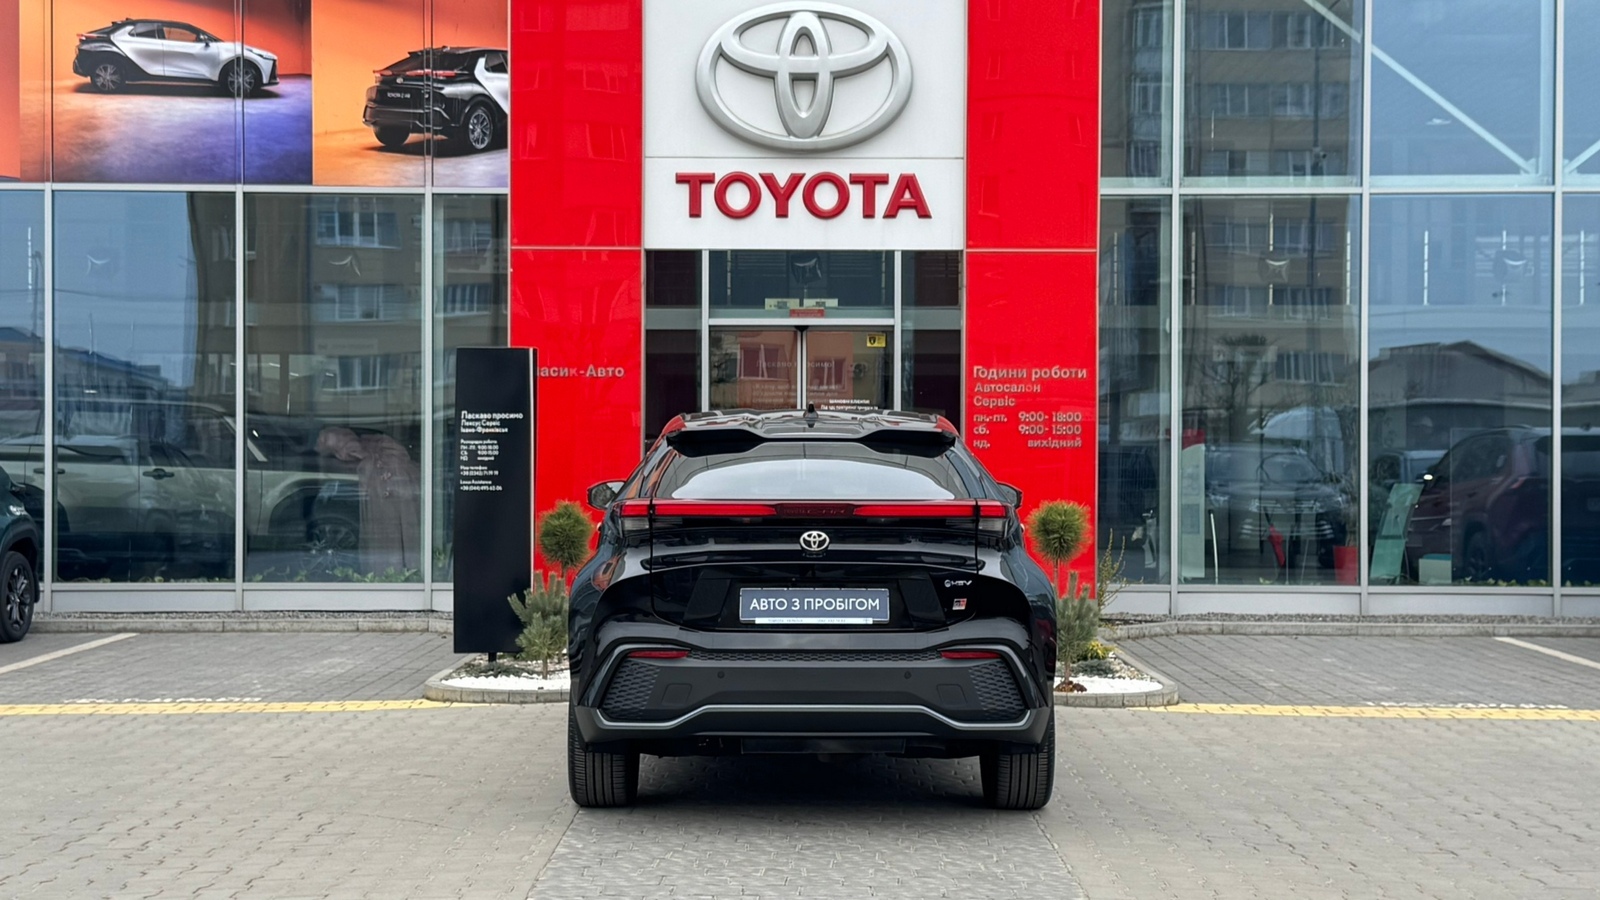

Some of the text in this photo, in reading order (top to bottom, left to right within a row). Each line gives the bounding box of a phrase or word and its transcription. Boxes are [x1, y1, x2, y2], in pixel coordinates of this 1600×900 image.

[675, 171, 932, 219] TOYOTA
[537, 364, 625, 377] асик-Авто
[973, 365, 1087, 381] Години роботи
[974, 383, 1041, 393] Автосалон
[973, 395, 1016, 408] Сервіс
[492, 412, 524, 420] просимо
[973, 424, 990, 435] сб.
[973, 437, 1082, 448] нд. вихідний
[749, 598, 880, 611] АВТО З ПРОБІГОМ
